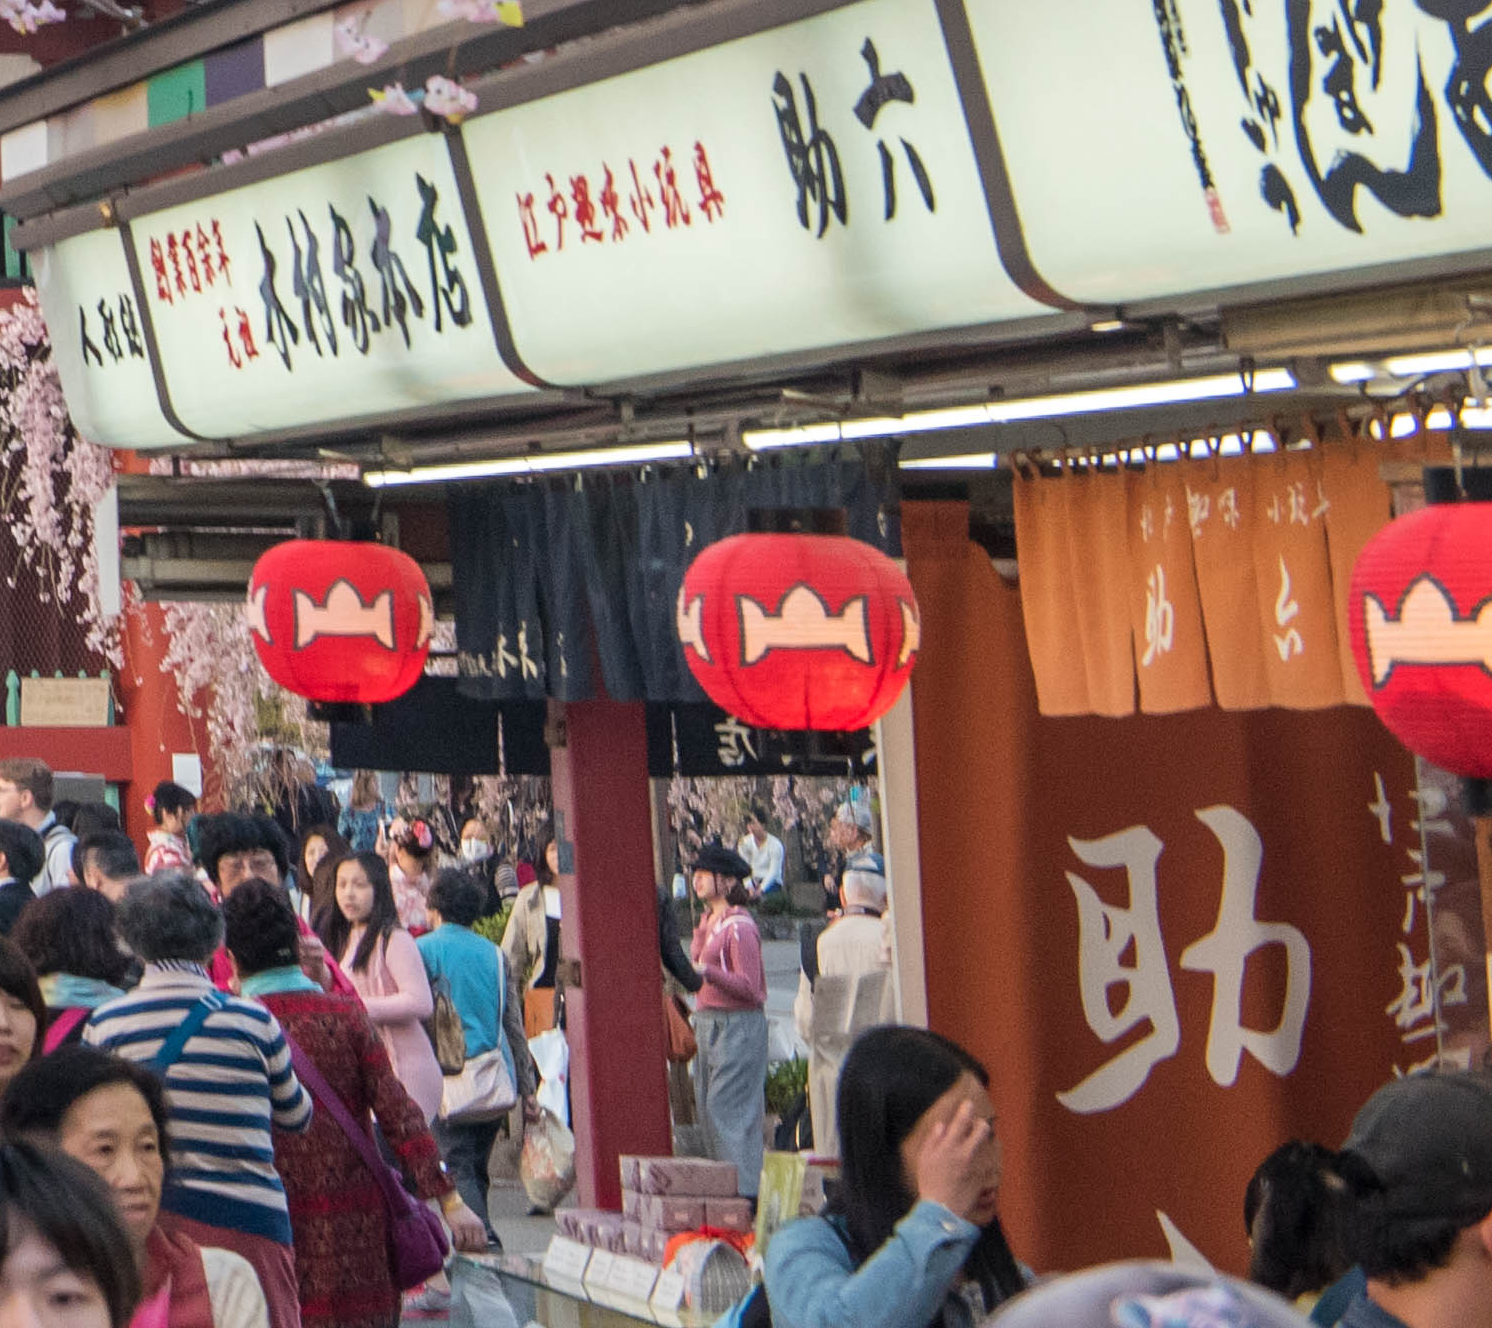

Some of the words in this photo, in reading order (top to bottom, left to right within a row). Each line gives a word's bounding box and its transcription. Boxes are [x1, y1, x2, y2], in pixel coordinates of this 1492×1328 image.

[770, 35, 936, 241] 助六
[253, 171, 473, 372] 木村家本店
